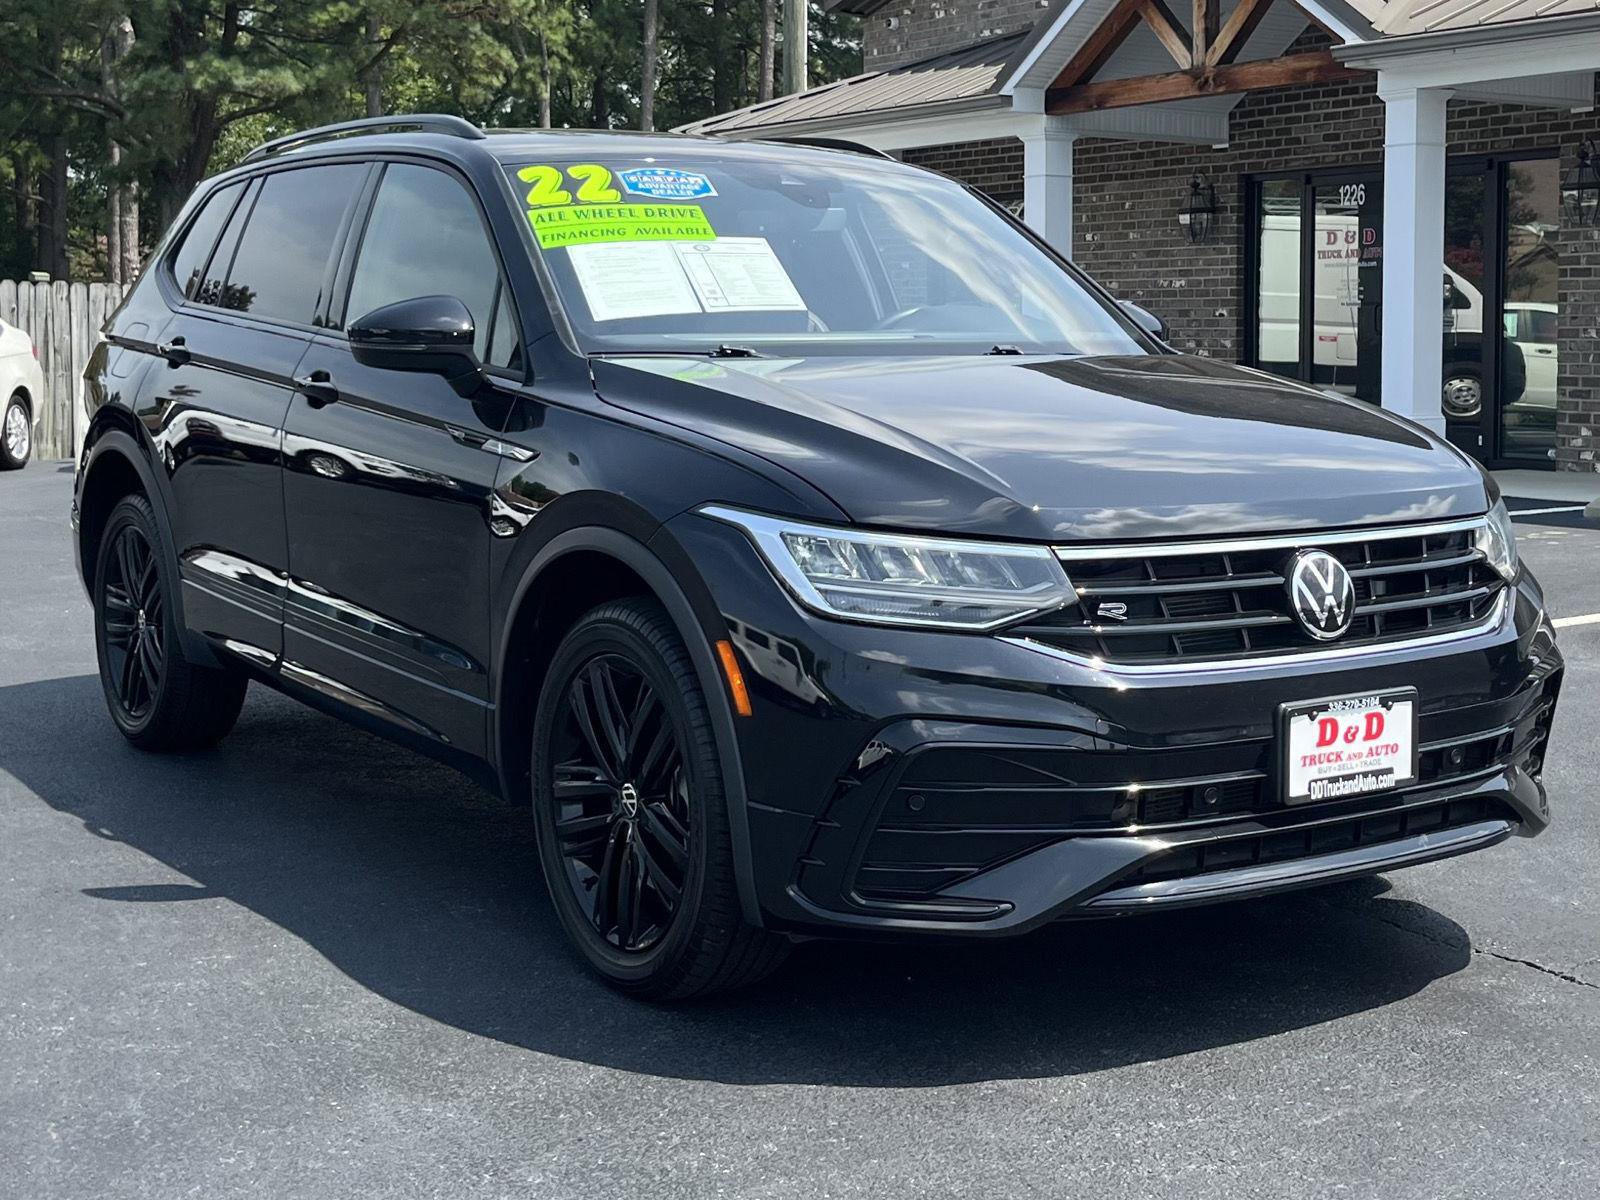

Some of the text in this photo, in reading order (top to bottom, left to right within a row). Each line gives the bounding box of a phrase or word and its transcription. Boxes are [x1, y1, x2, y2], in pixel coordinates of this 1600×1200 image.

[517, 164, 622, 206] 22
[638, 182, 701, 191] ADVANTAGE
[652, 188, 695, 197] DEALER
[1339, 184, 1366, 206] 1226
[535, 207, 700, 225] ALL WHEEL DRIVE
[541, 226, 711, 243] FINANCING AVAILABLE
[1326, 228, 1376, 245] D & D
[1317, 250, 1343, 260] TRUCK
[1345, 248, 1361, 259] AND
[1316, 711, 1385, 748] D & D
[1301, 743, 1399, 767] TRUCK AND AUTO
[1318, 758, 1382, 774] BUY SELL TRADE
[1311, 772, 1396, 800] DDTruckandAuto.com
